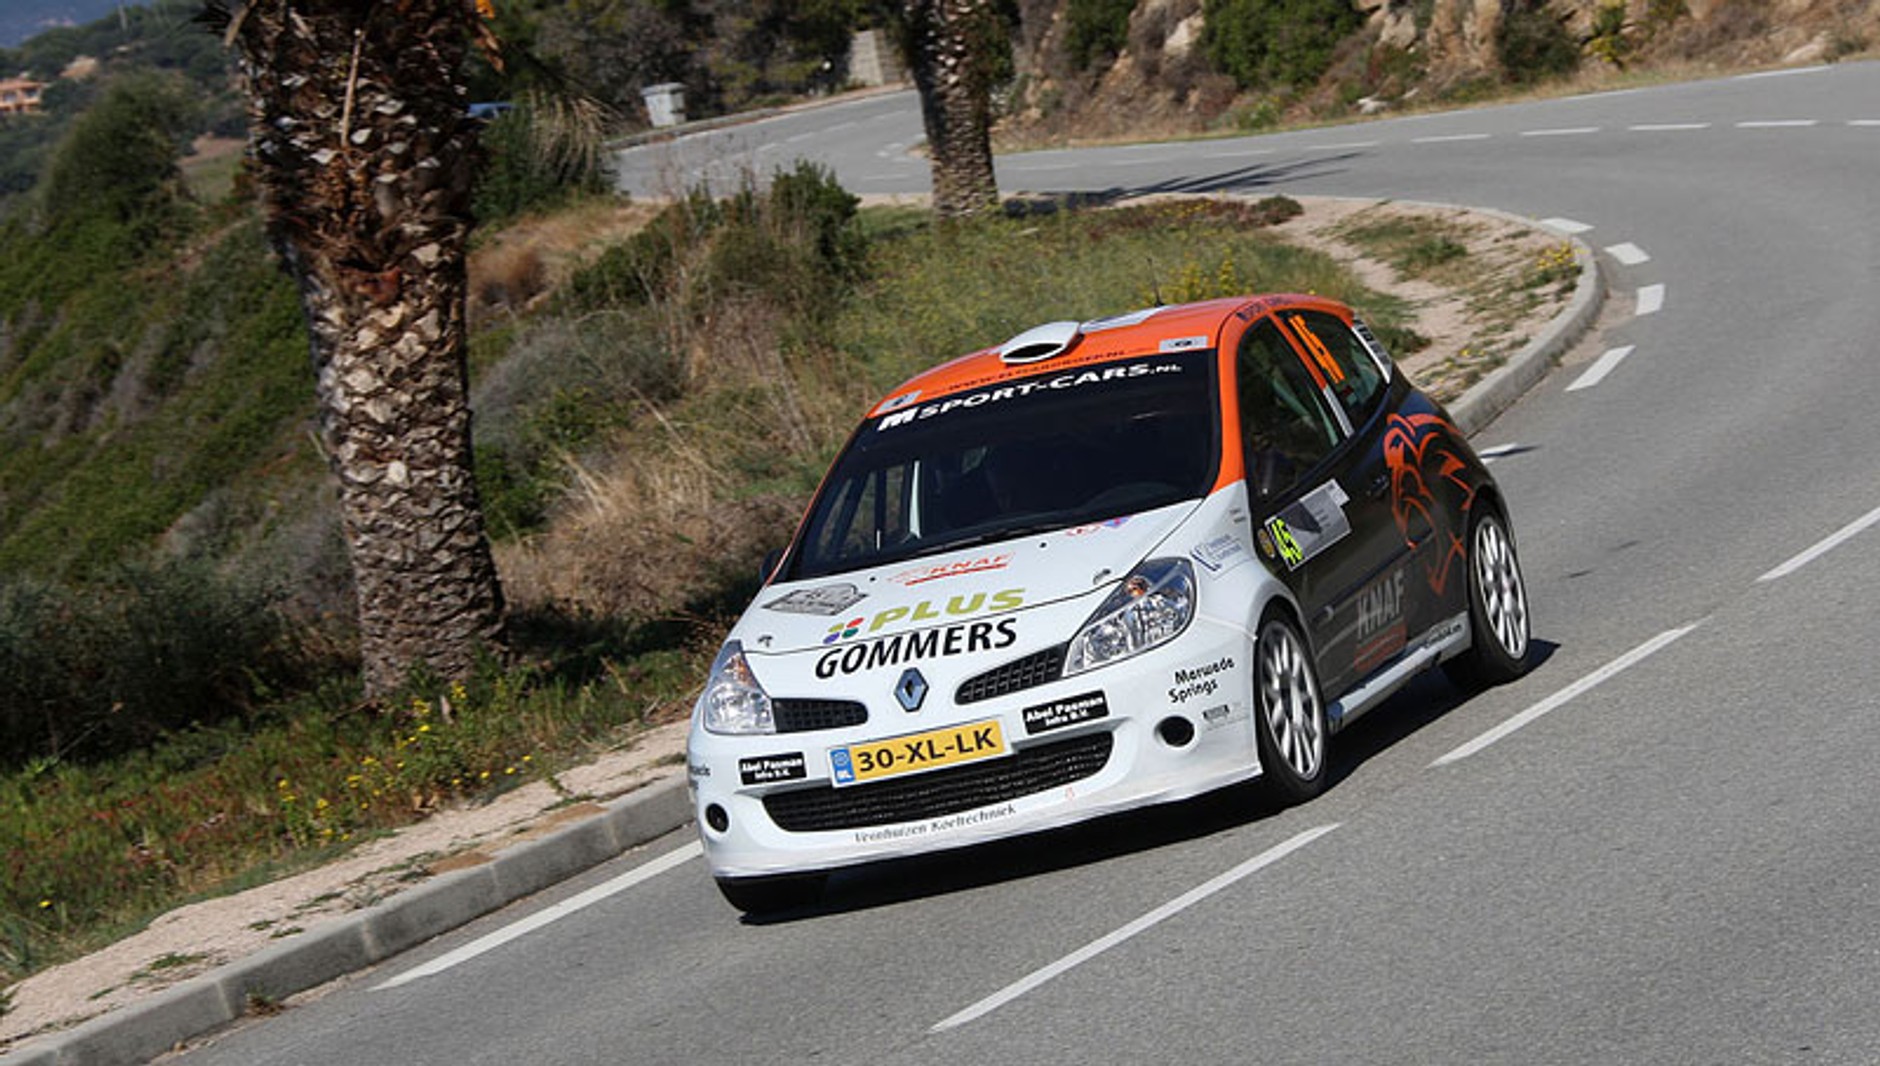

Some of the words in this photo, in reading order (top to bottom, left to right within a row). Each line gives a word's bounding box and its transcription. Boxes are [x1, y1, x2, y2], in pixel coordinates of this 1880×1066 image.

[1287, 314, 1345, 385] 45
[1271, 518, 1303, 566] 45
[868, 588, 1026, 632] PLUS
[815, 618, 1017, 680] GOMMERS
[1174, 657, 1235, 685] Merwede
[1168, 679, 1219, 703] Springs
[857, 727, 996, 772] 30-XL-LK
